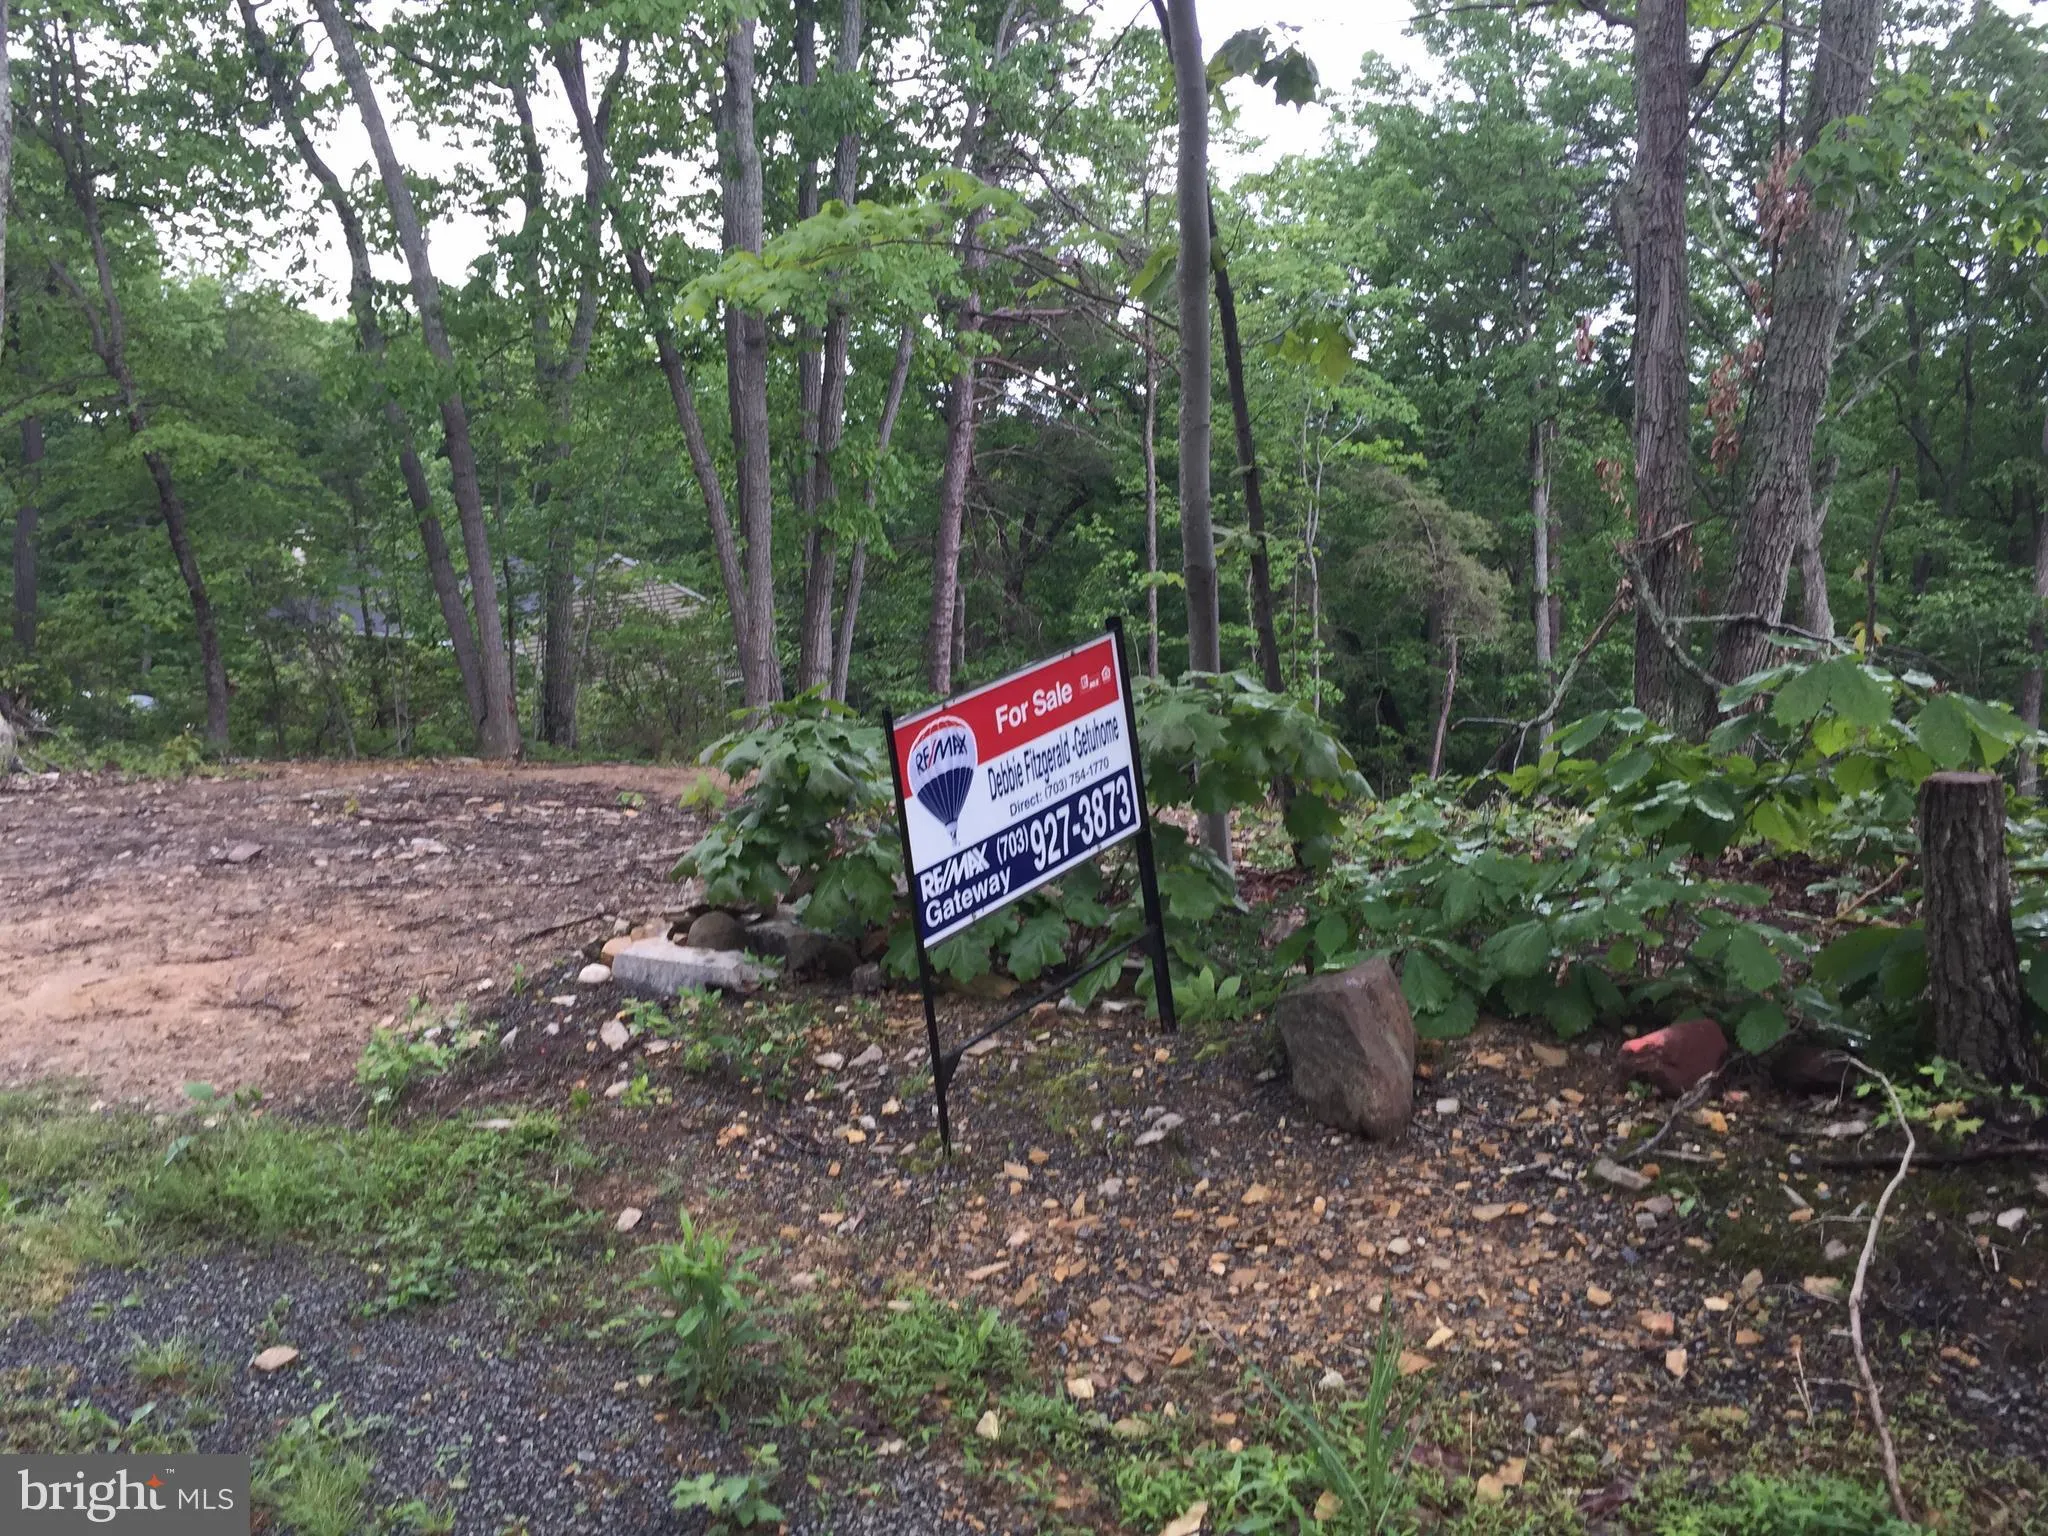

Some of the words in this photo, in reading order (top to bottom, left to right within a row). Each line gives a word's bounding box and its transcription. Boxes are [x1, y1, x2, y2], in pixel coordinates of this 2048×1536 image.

[995, 702, 1029, 734] For
[1033, 681, 1073, 717] Sale
[915, 734, 967, 772] RE/MAX
[988, 765, 1024, 801] Debbie
[1024, 737, 1070, 785] Fitzgerald
[1009, 792, 1043, 817] Direct:
[1045, 779, 1067, 800] (703)
[1069, 757, 1109, 787] 754-1770
[920, 842, 990, 902] RE/MAX
[997, 827, 1029, 861] (703)
[1031, 775, 1131, 871] 927-3873
[925, 866, 1011, 928] Gateway
